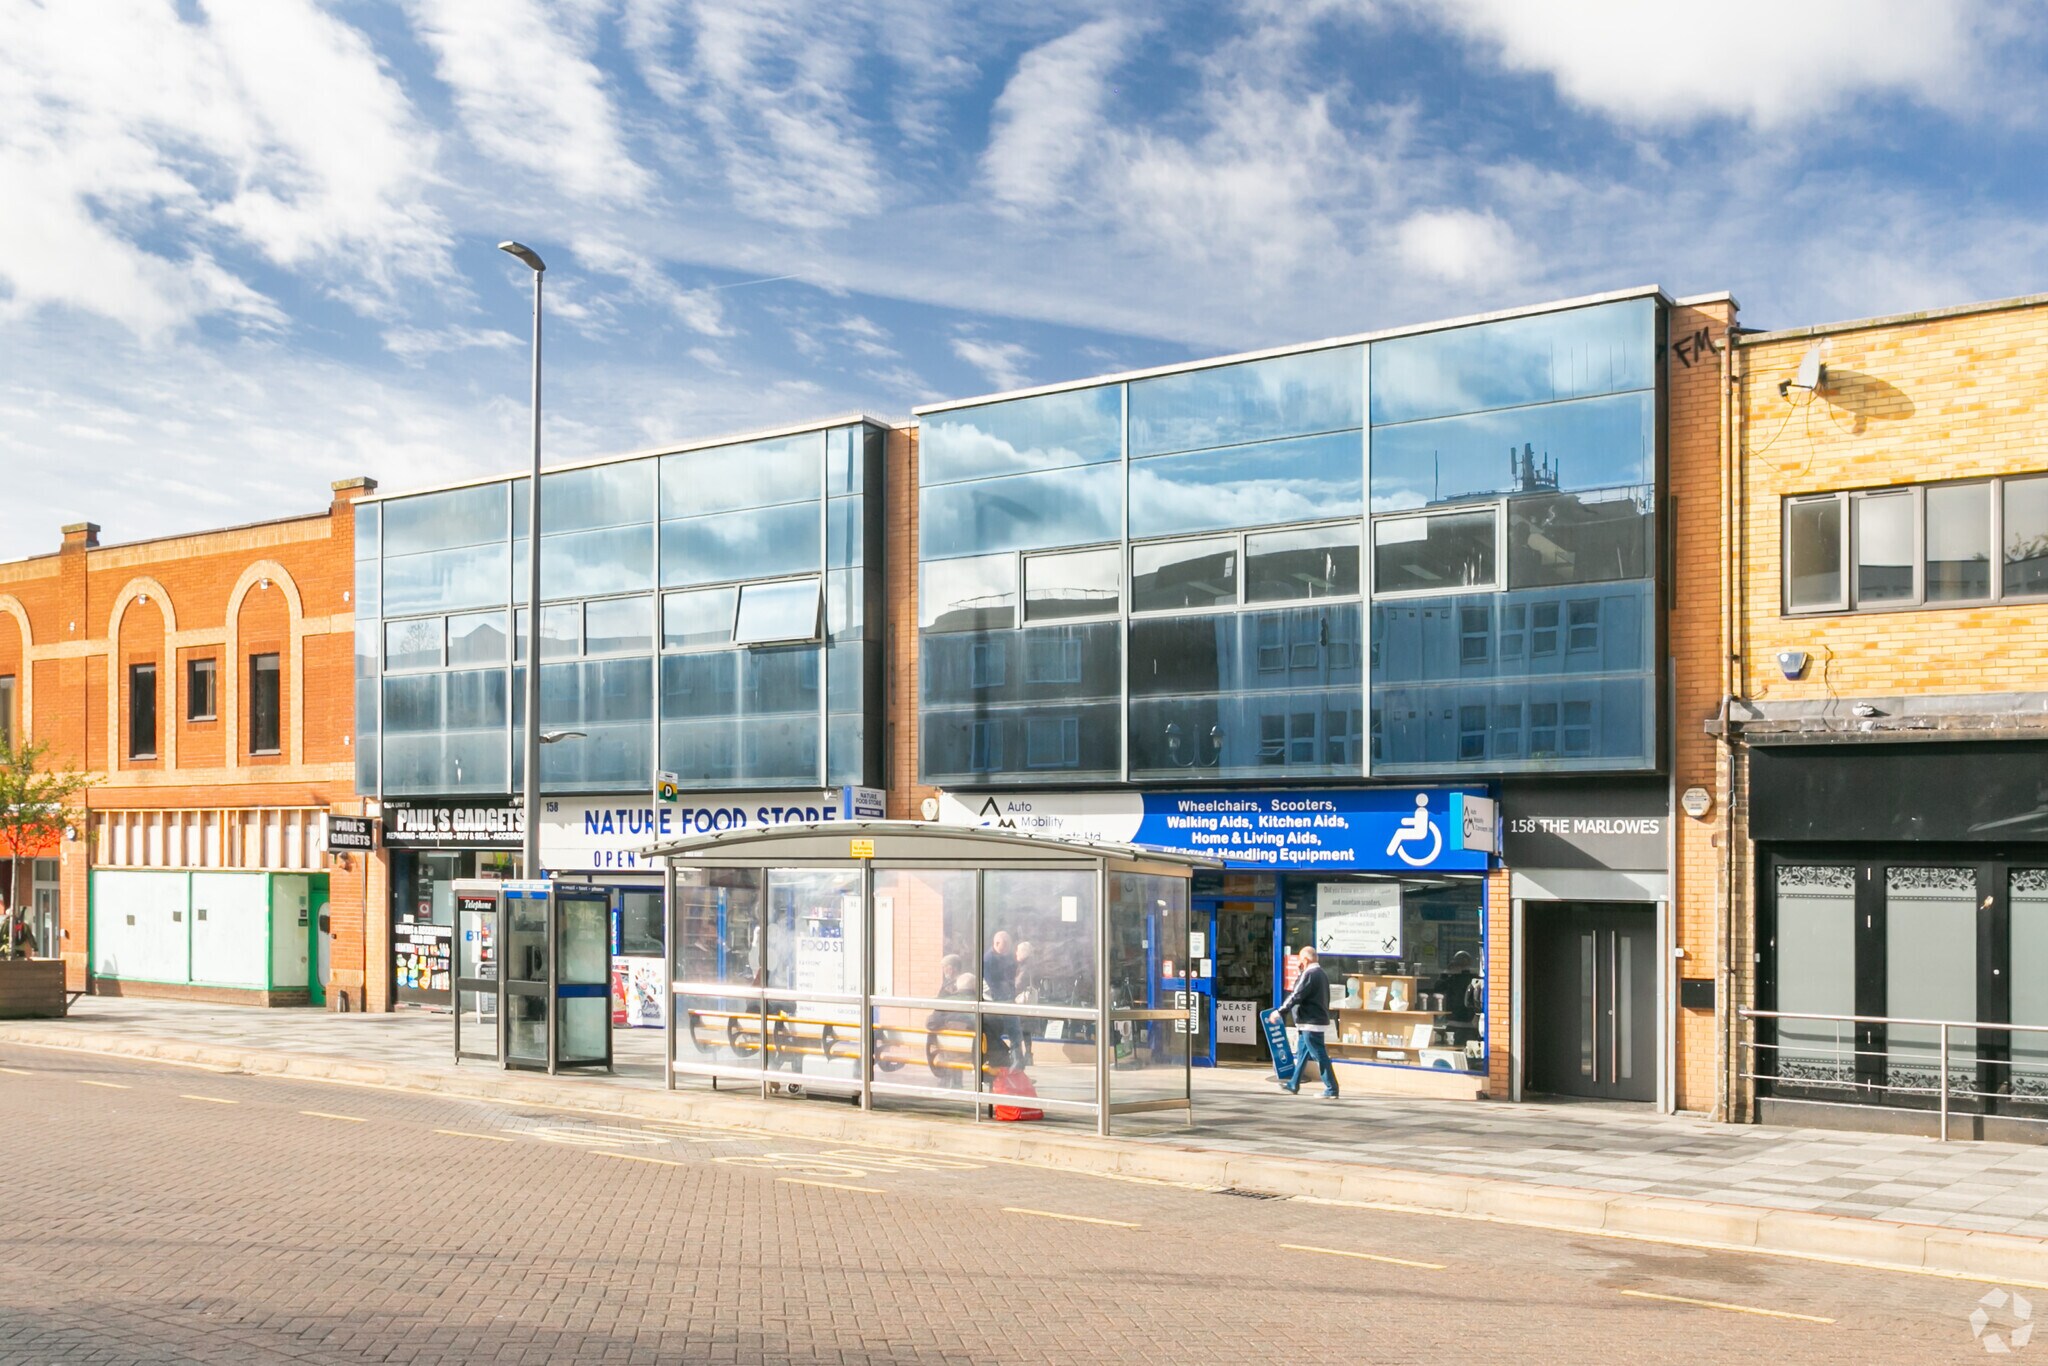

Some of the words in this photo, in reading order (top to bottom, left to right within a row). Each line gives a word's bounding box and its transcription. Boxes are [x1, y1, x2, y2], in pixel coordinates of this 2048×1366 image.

[1673, 326, 1716, 368] FM
[665, 786, 673, 797] D
[546, 802, 558, 812] 158
[1007, 802, 1032, 812] Auto
[1178, 800, 1262, 813] Wheelchairs,
[1271, 799, 1337, 812] Scooters,
[335, 820, 366, 833] PAUL'S
[397, 808, 451, 832] PAUL'S
[452, 808, 524, 832] GADGETS
[585, 809, 671, 835] NATURE
[682, 807, 747, 834] FOOD
[1021, 817, 1064, 829] Mobility
[1167, 816, 1217, 830] Walking
[1219, 816, 1253, 829] Aids,
[1258, 815, 1311, 828] Kitchen
[1313, 815, 1349, 829] Aids,
[1510, 820, 1536, 833] 158
[1540, 819, 1569, 833] THE
[1573, 819, 1660, 834] MARLOWES
[331, 833, 370, 846] GADGETS
[418, 832, 453, 840] UNLOCKING
[456, 832, 469, 840] BUY
[469, 832, 475, 840] &
[475, 832, 490, 840] SELL
[1192, 832, 1229, 844] Home
[1231, 832, 1241, 844] &
[1244, 831, 1285, 847] Living
[1287, 831, 1322, 846] Aids,
[594, 850, 635, 867] OPEN
[1217, 847, 1277, 863] Handling
[1280, 848, 1354, 862] Equipment
[464, 900, 492, 910] Telephone
[466, 930, 480, 941] BT
[801, 939, 830, 952] FOOD
[1216, 1003, 1252, 1011] PLEASE
[1221, 1014, 1247, 1022] WAIT
